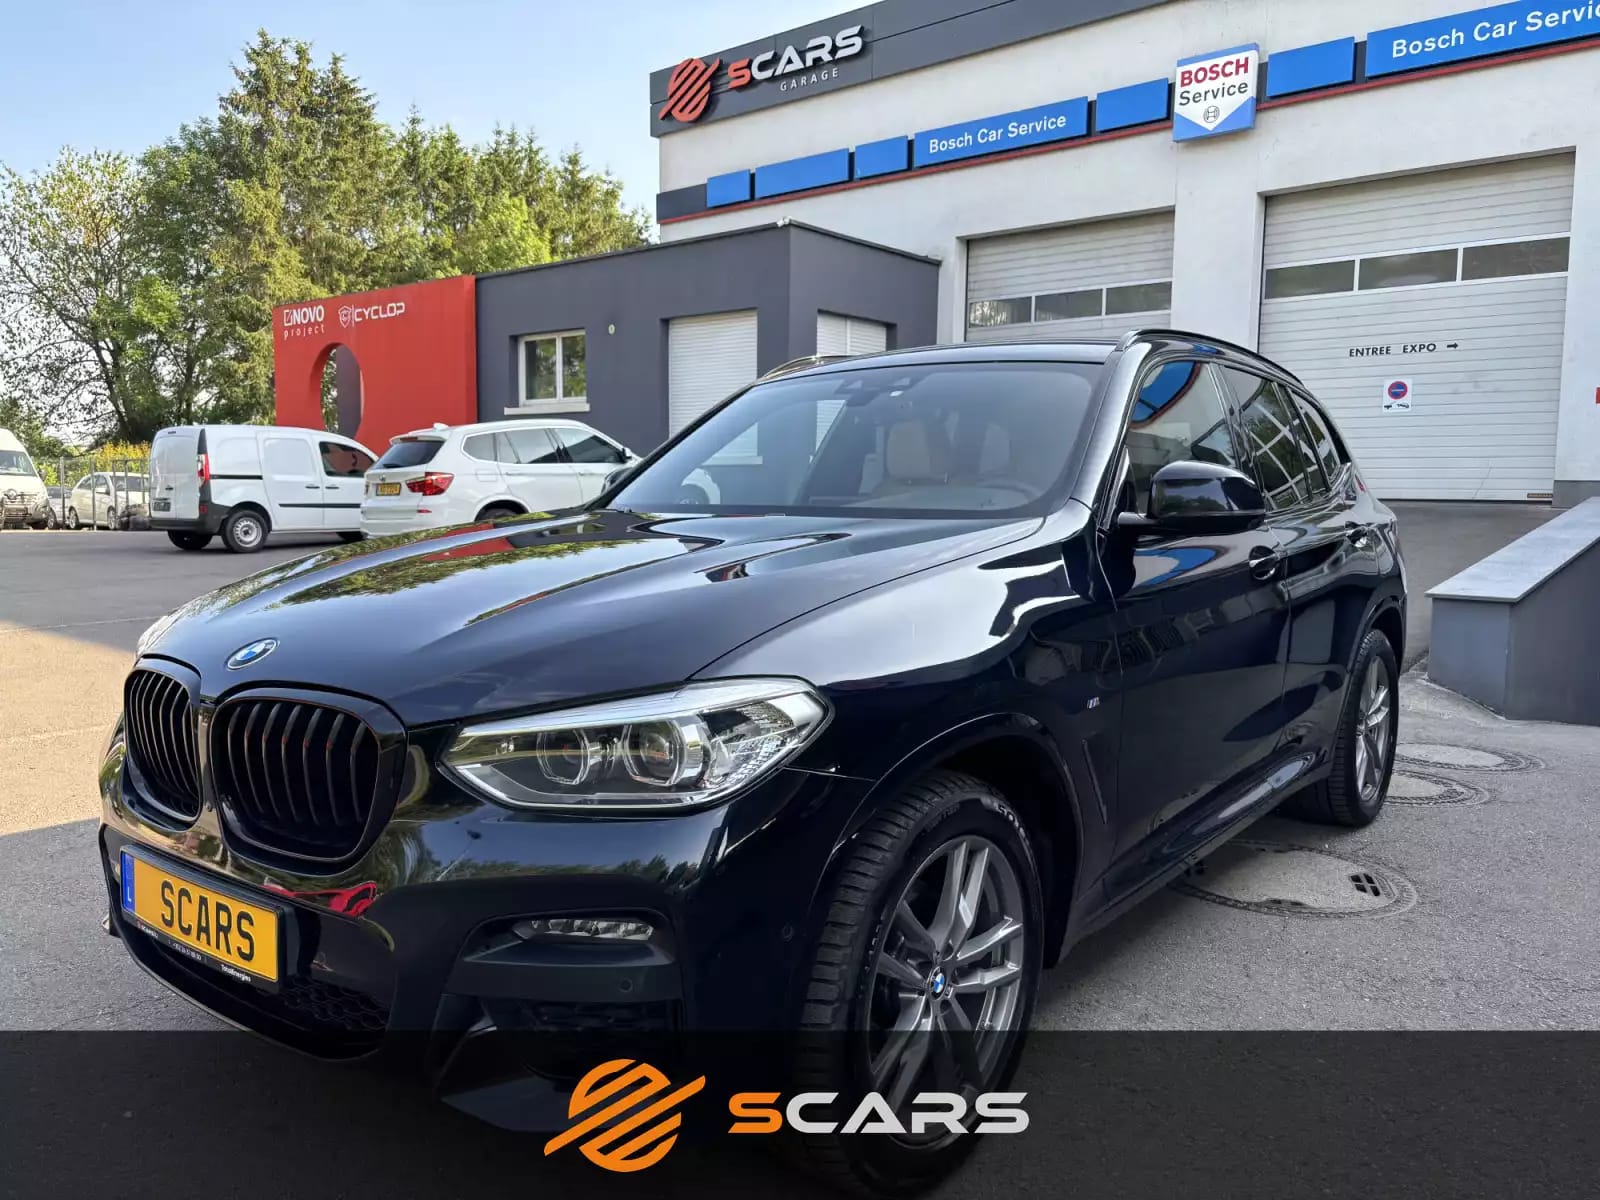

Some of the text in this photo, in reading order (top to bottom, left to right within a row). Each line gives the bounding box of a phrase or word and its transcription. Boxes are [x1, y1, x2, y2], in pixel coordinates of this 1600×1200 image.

[1392, 29, 1464, 58] Bosch
[1473, 19, 1517, 42] Car
[728, 25, 863, 89] SCARS
[1181, 57, 1249, 88] BOSCH
[780, 68, 838, 91] GARAGE
[1179, 82, 1248, 106] Service
[929, 114, 1067, 154] Bosch Car Service
[283, 324, 324, 340] project
[1349, 343, 1436, 357] ENTREE EXPO
[161, 880, 255, 962] SCARS
